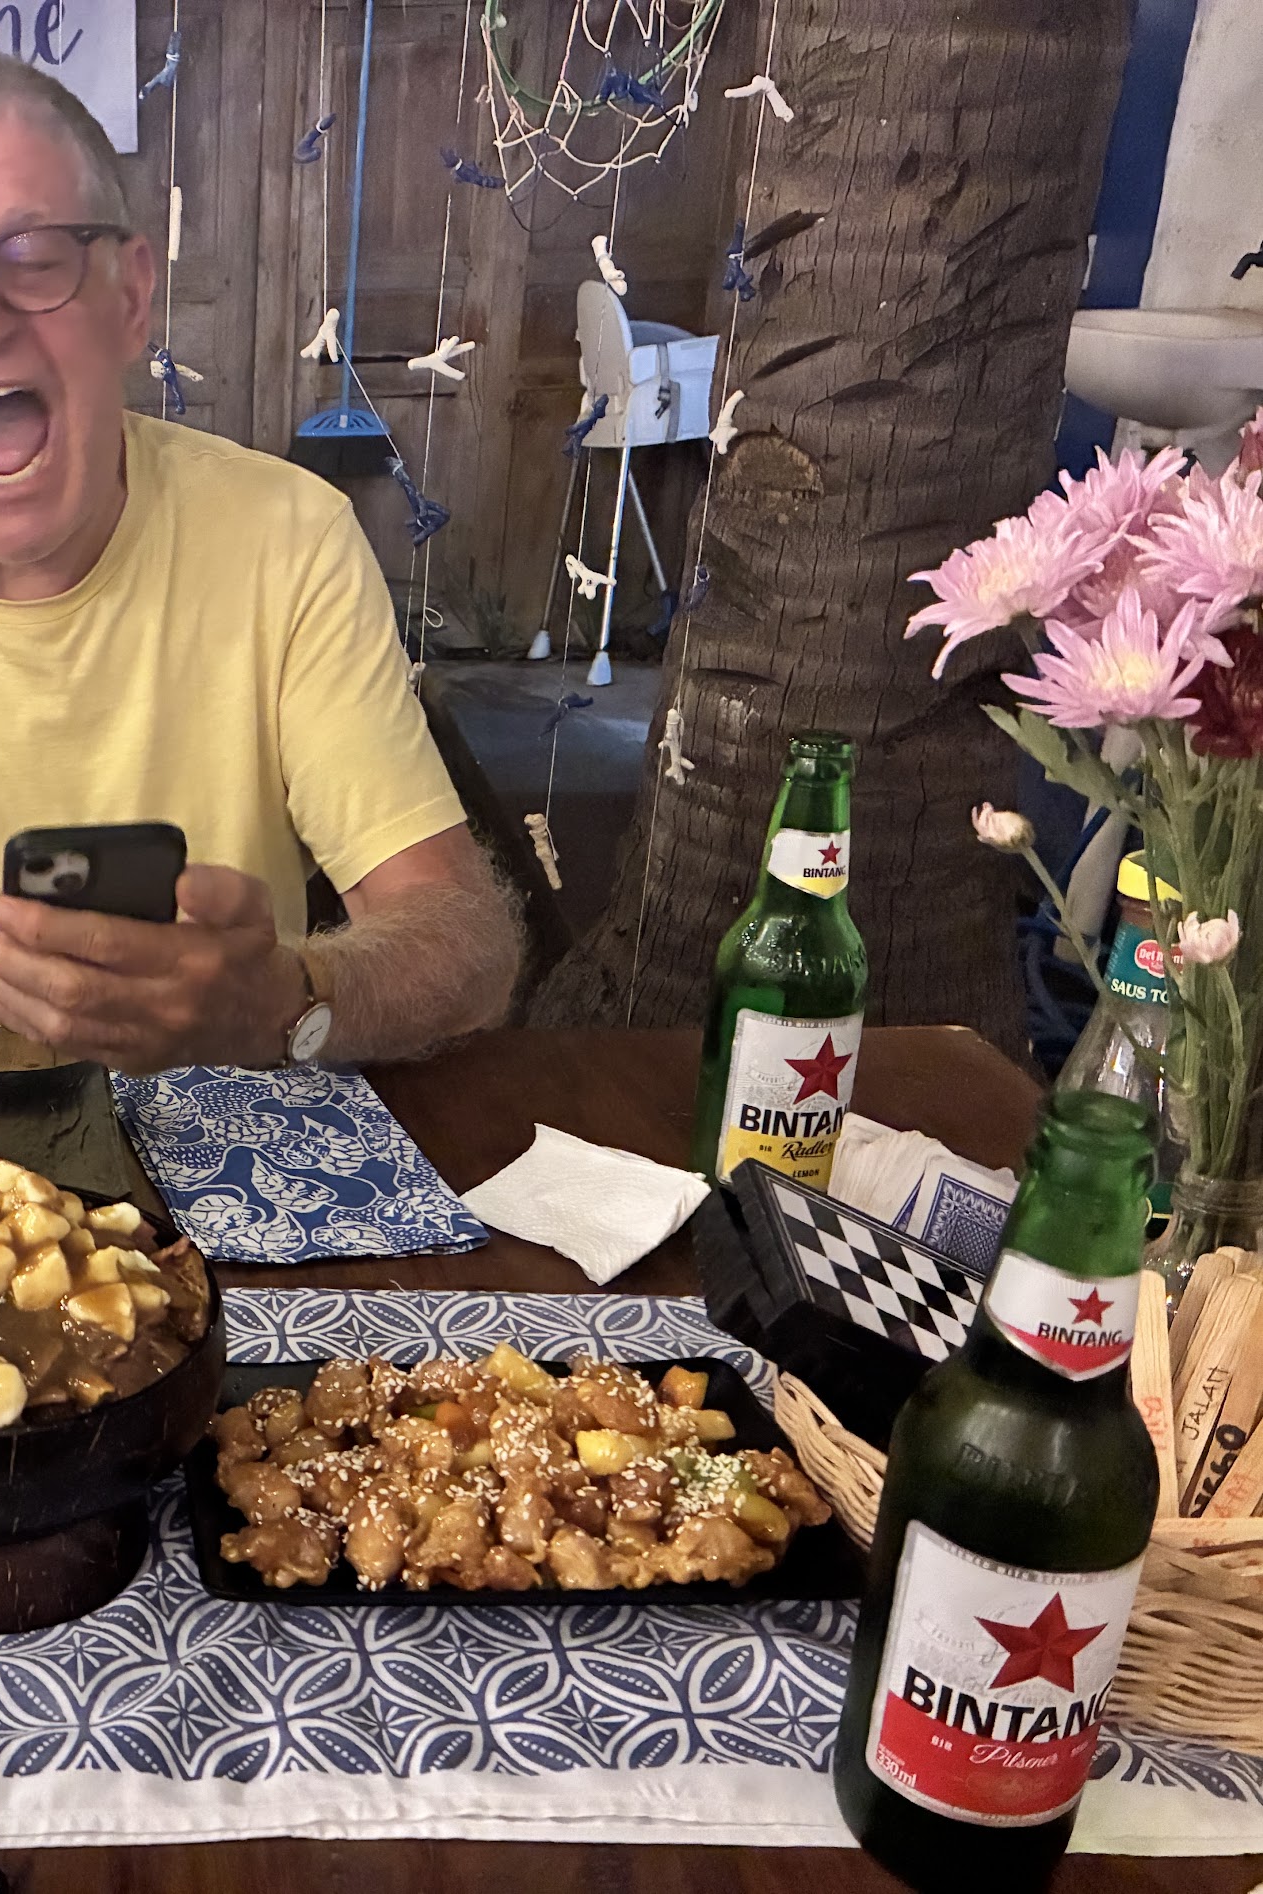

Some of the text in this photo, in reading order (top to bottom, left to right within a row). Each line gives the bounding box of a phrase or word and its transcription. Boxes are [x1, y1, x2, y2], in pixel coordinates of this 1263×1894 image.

[1111, 977, 1147, 1000] SAUS
[739, 1103, 849, 1138] BINTAN
[781, 1140, 833, 1162] Radler
[792, 1168, 820, 1179] LEMON
[1038, 1321, 1123, 1347] BINTANG
[930, 1734, 953, 1752] BIR
